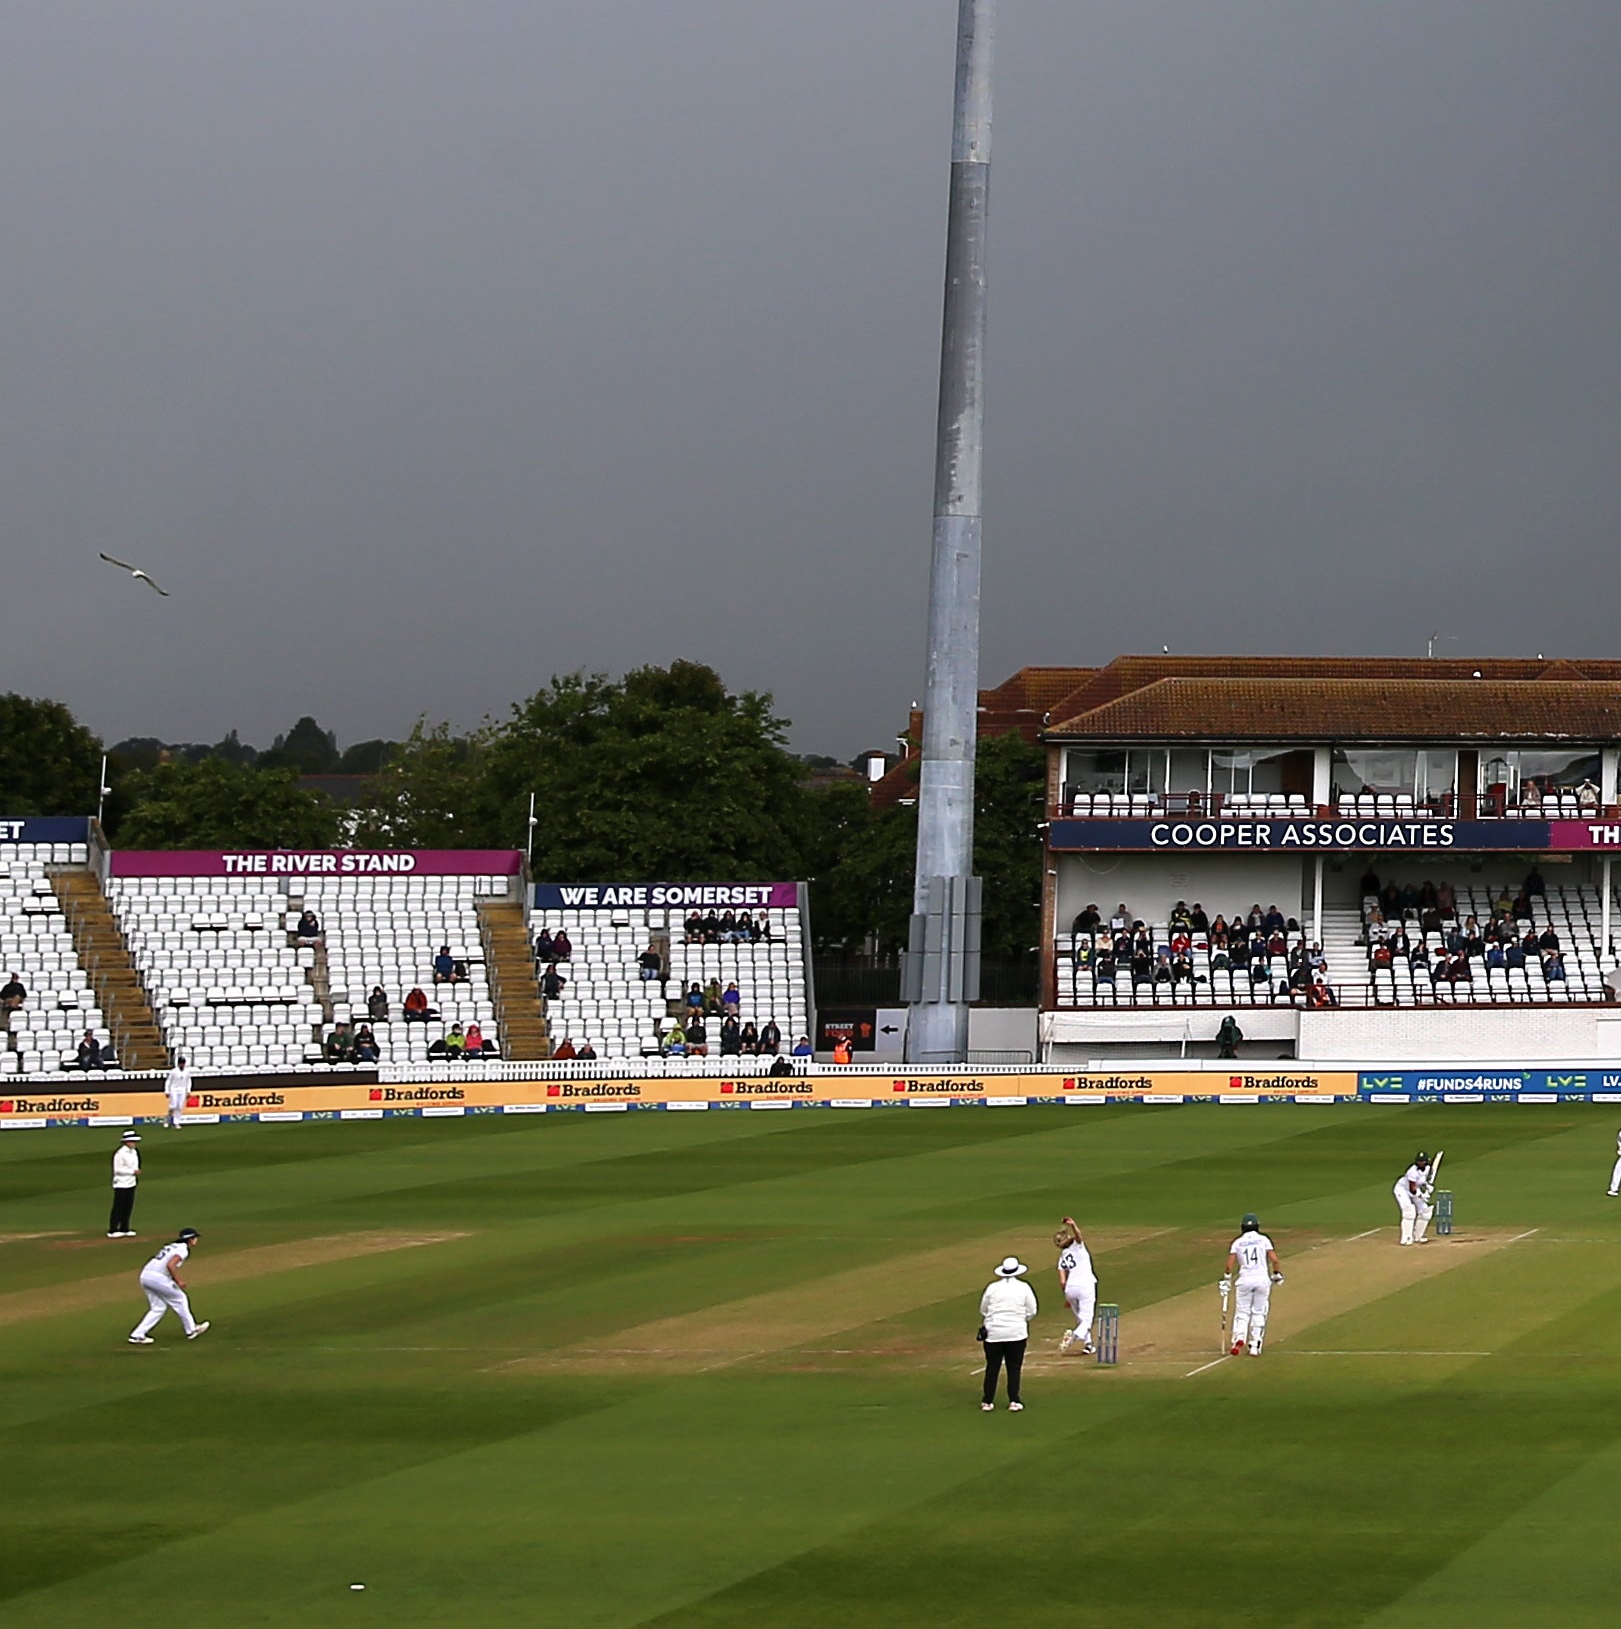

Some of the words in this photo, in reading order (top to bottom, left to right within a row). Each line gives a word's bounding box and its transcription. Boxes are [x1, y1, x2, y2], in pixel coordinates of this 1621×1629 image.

[1152, 825, 1270, 845] COOPER
[1281, 825, 1453, 845] ASSOCIATES
[223, 855, 267, 871] THE
[272, 855, 336, 871] RIVER
[341, 855, 415, 871] STAND
[560, 888, 598, 905] WE
[602, 888, 647, 905] ARE
[652, 887, 772, 904] SOMERSET
[736, 1082, 813, 1094] Bradfords
[908, 1080, 984, 1092] Bradfords
[1077, 1077, 1153, 1089] Bradfords
[1244, 1076, 1318, 1088] Bradfords
[1417, 1076, 1522, 1090] #FUNDS4RUNS
[384, 1087, 465, 1101] Bradfords
[562, 1084, 641, 1097] Bradfords
[16, 1098, 99, 1112] Bradfords
[202, 1093, 284, 1107] Bradfords
[1243, 1247, 1258, 1265] 14
